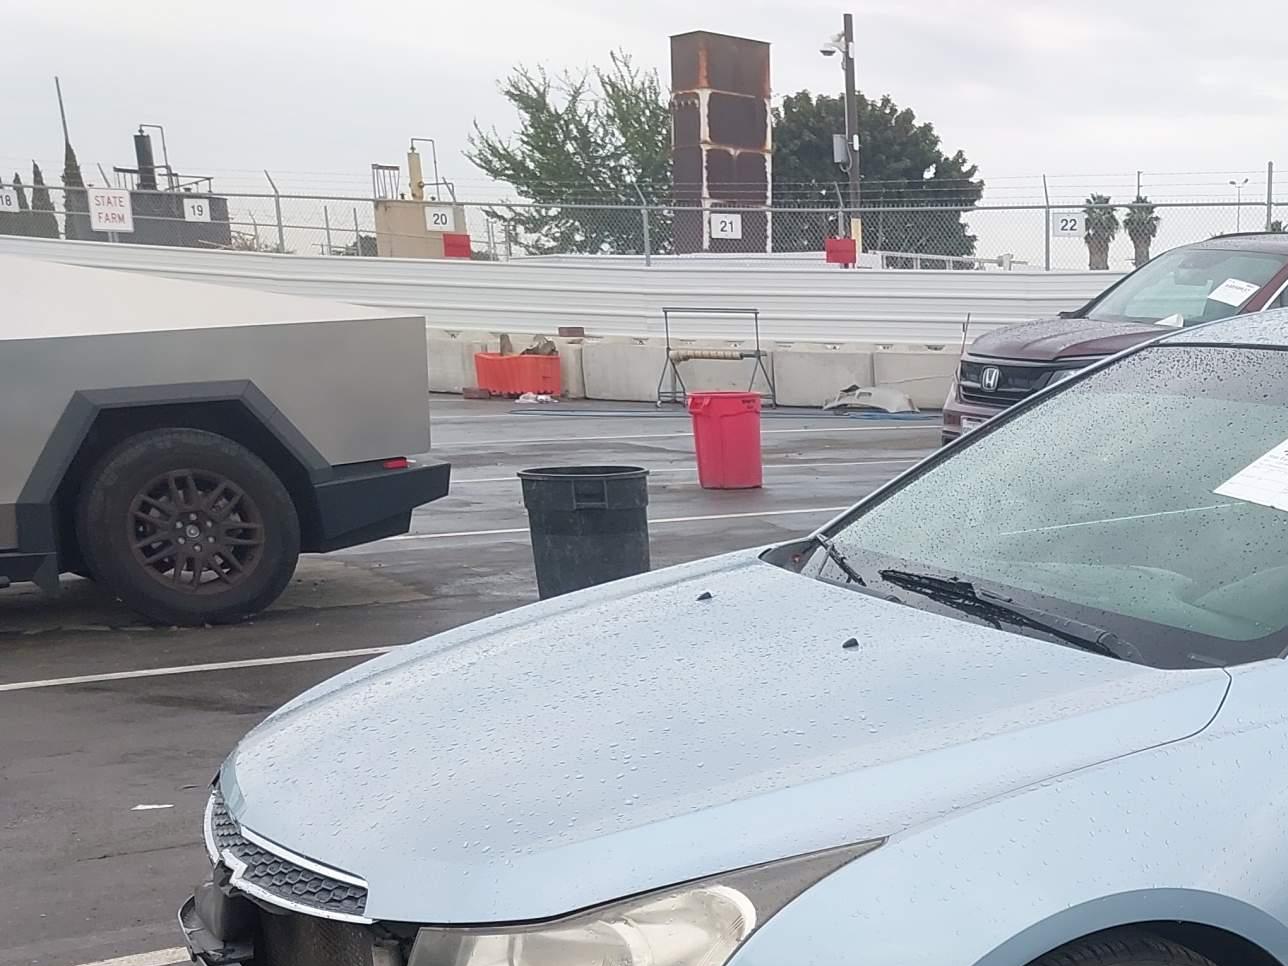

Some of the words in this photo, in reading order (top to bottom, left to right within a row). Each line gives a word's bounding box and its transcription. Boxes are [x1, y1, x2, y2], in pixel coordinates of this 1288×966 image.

[0, 195, 12, 207] 18
[94, 194, 125, 208] STATE
[190, 204, 204, 217] 19
[97, 211, 126, 225] FARM
[432, 213, 448, 226] 20
[719, 220, 734, 233] 21
[1060, 218, 1077, 232] 22
